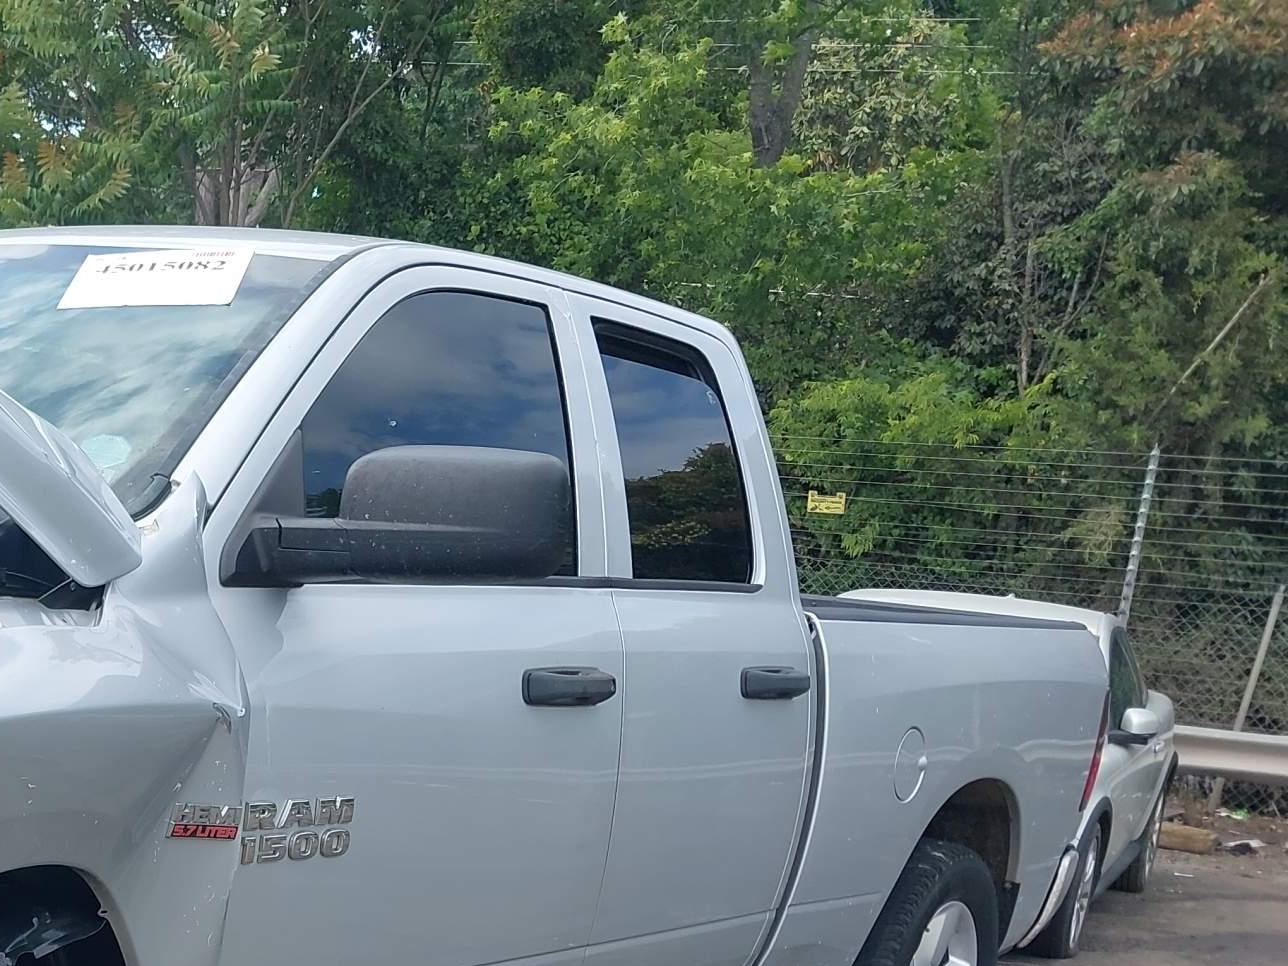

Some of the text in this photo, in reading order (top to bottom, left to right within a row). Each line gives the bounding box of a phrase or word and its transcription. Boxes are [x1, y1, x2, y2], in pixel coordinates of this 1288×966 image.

[96, 260, 227, 274] 45015082
[245, 797, 355, 831] RAM
[173, 825, 237, 839] 5.7 LITER
[241, 829, 351, 865] 1500
